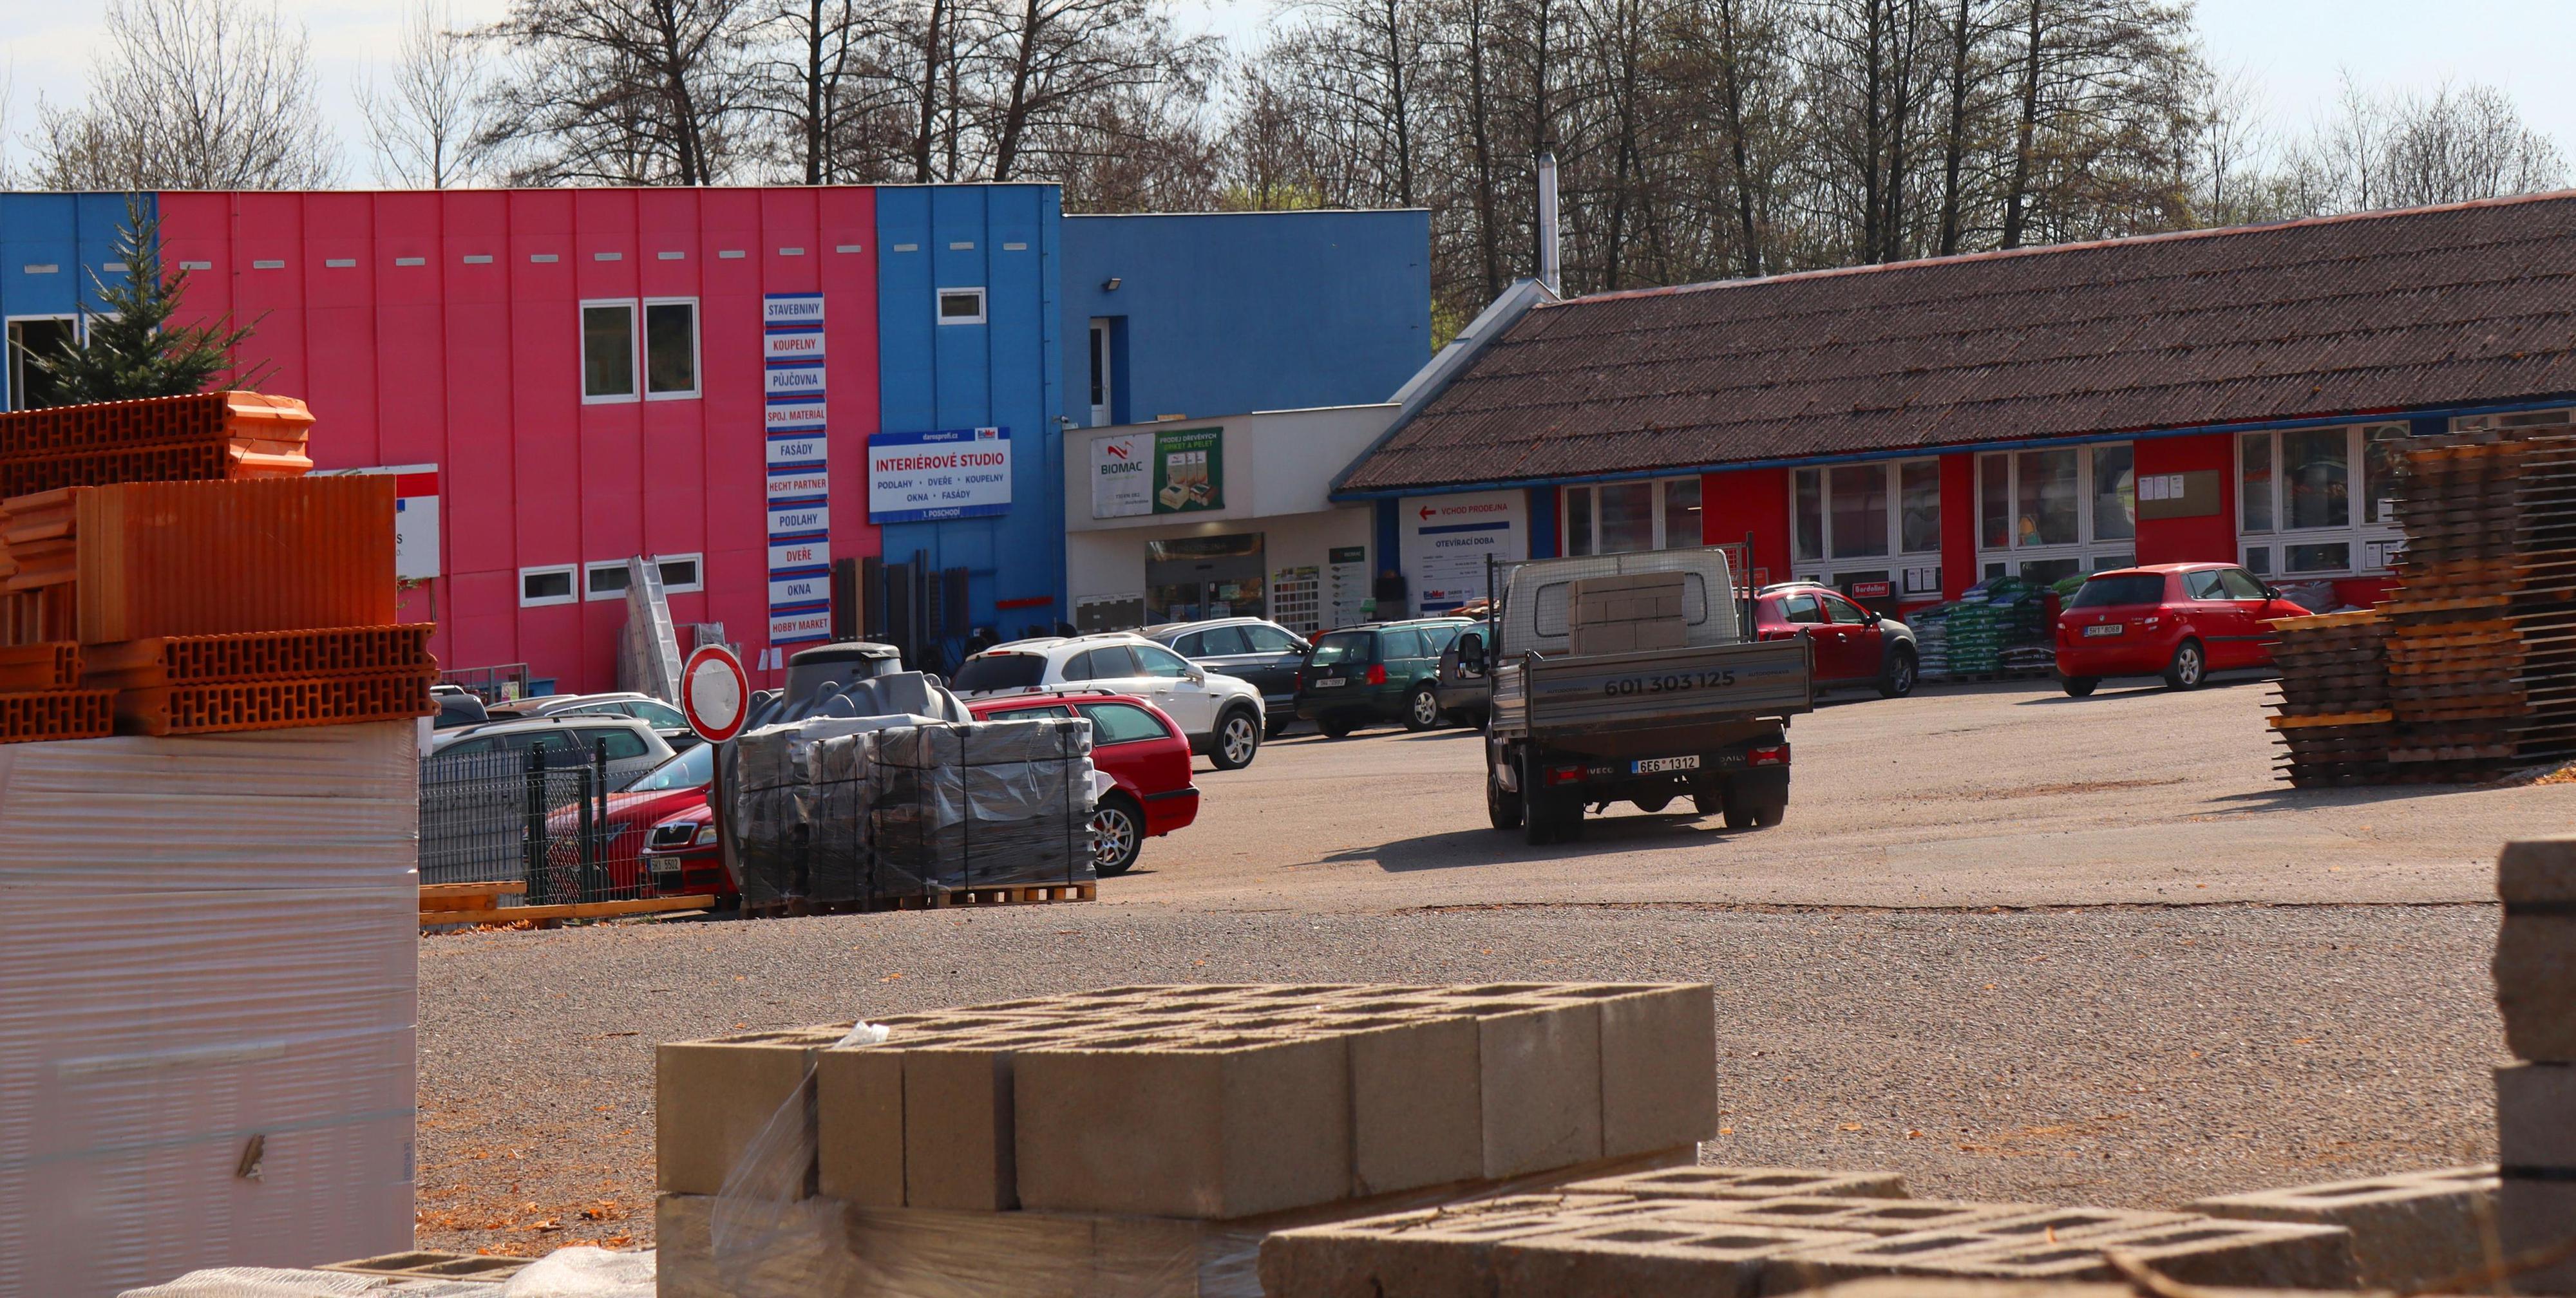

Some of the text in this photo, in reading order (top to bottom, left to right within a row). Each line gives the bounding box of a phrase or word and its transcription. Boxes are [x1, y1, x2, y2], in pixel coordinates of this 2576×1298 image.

[768, 303, 820, 315] STAVEBNINY
[773, 339, 817, 351] KOUPELNY
[773, 372, 818, 386] PŮJČOVNA
[768, 408, 825, 421] SPOJ. MATERIÁL
[1160, 436, 1181, 444] PRODEJ
[1194, 440, 1213, 448] PELET
[781, 441, 813, 456] FASÁDY
[876, 452, 1004, 472] INTERIÉROVÉ STUDIO
[1101, 462, 1142, 475] BIOMAC
[769, 478, 826, 492] HECHT PARTNER
[878, 473, 1004, 489] PODLAHY DVEŘE KOUPELNY
[907, 490, 971, 502] OKNA FASÁDY
[929, 507, 960, 518] POSCHODÍ
[1442, 503, 1508, 516] VCHOD PRODEJNA
[779, 514, 818, 527] PODLAHY
[1435, 537, 1495, 547] OTEVÍRACÍ DOBA
[786, 547, 812, 562] DVEŘE
[788, 583, 811, 596] OKNA
[773, 618, 828, 634] HOBBY MARKET
[1604, 678, 1642, 696] 601
[1649, 675, 1693, 692] 303
[1697, 670, 1736, 688] 125
[1587, 766, 1614, 775] IVECO
[1640, 757, 1694, 773] 6E6 1312
